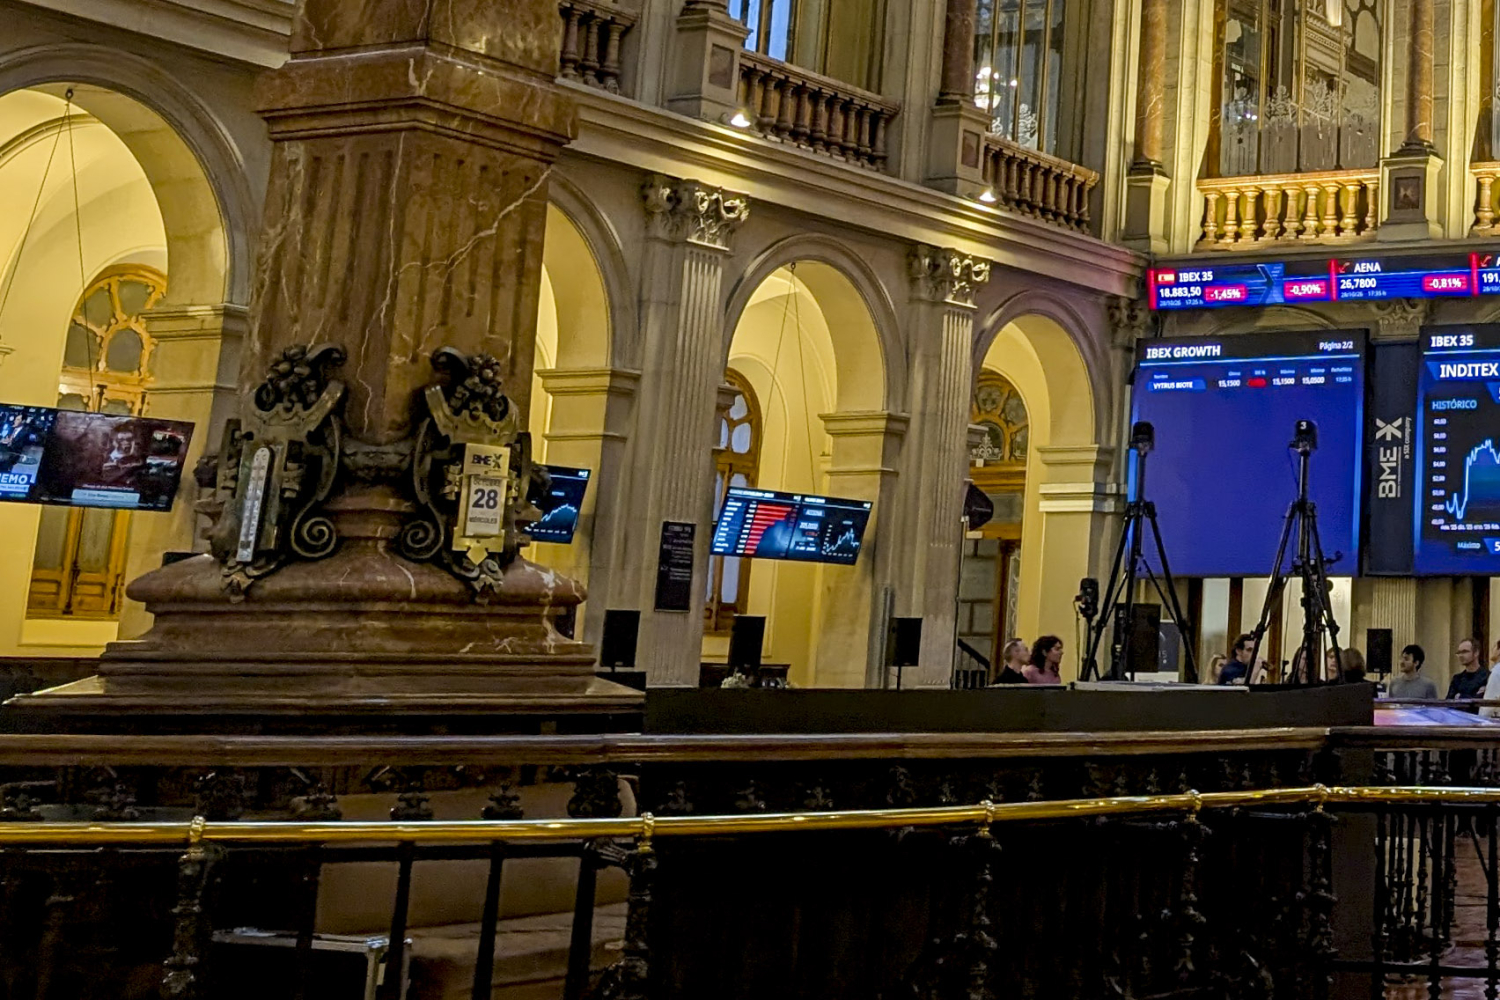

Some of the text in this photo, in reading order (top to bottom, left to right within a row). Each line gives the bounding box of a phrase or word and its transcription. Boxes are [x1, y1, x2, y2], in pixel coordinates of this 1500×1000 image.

[1353, 262, 1381, 273] AENA
[1179, 271, 1213, 282] IBEX 35
[1289, 283, 1321, 295] -0,90%
[1340, 278, 1462, 290] 26,7800 -0,81%
[1159, 286, 1241, 300] 18.883,50 -1,45%
[1430, 335, 1474, 348] IBEX 35
[1146, 345, 1221, 359] IBEX GROWTH
[1439, 362, 1500, 379] INDITEX
[1431, 399, 1478, 411] HISTÓRICO
[1300, 421, 1307, 430] 3
[0, 473, 28, 485] EMO
[472, 488, 498, 510] 28
